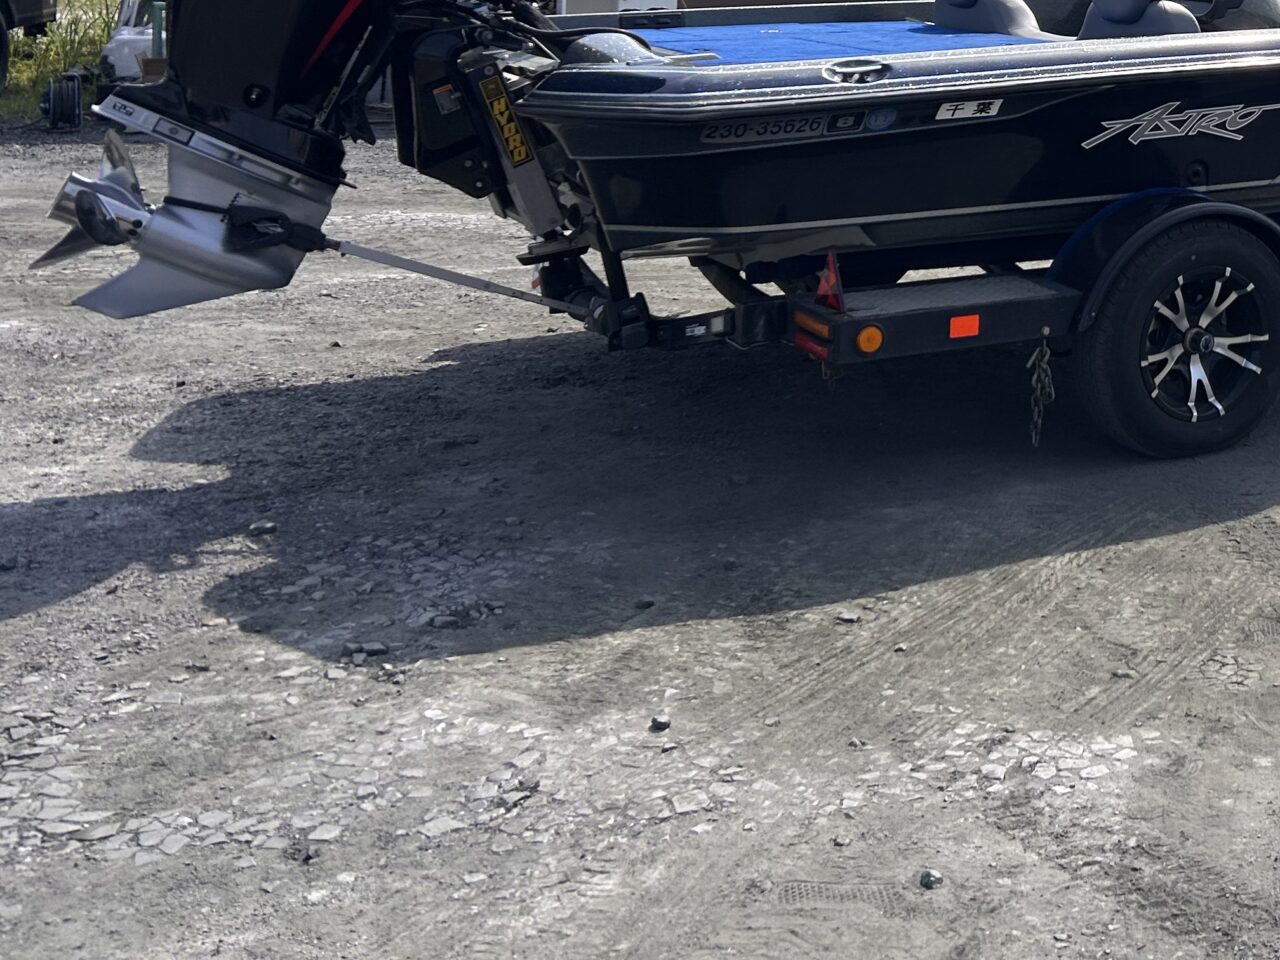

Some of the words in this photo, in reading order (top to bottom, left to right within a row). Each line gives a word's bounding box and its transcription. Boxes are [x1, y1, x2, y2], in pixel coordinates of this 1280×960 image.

[945, 101, 993, 117] 千葉
[491, 97, 528, 162] HYDRO
[704, 116, 823, 139] 230-35626
